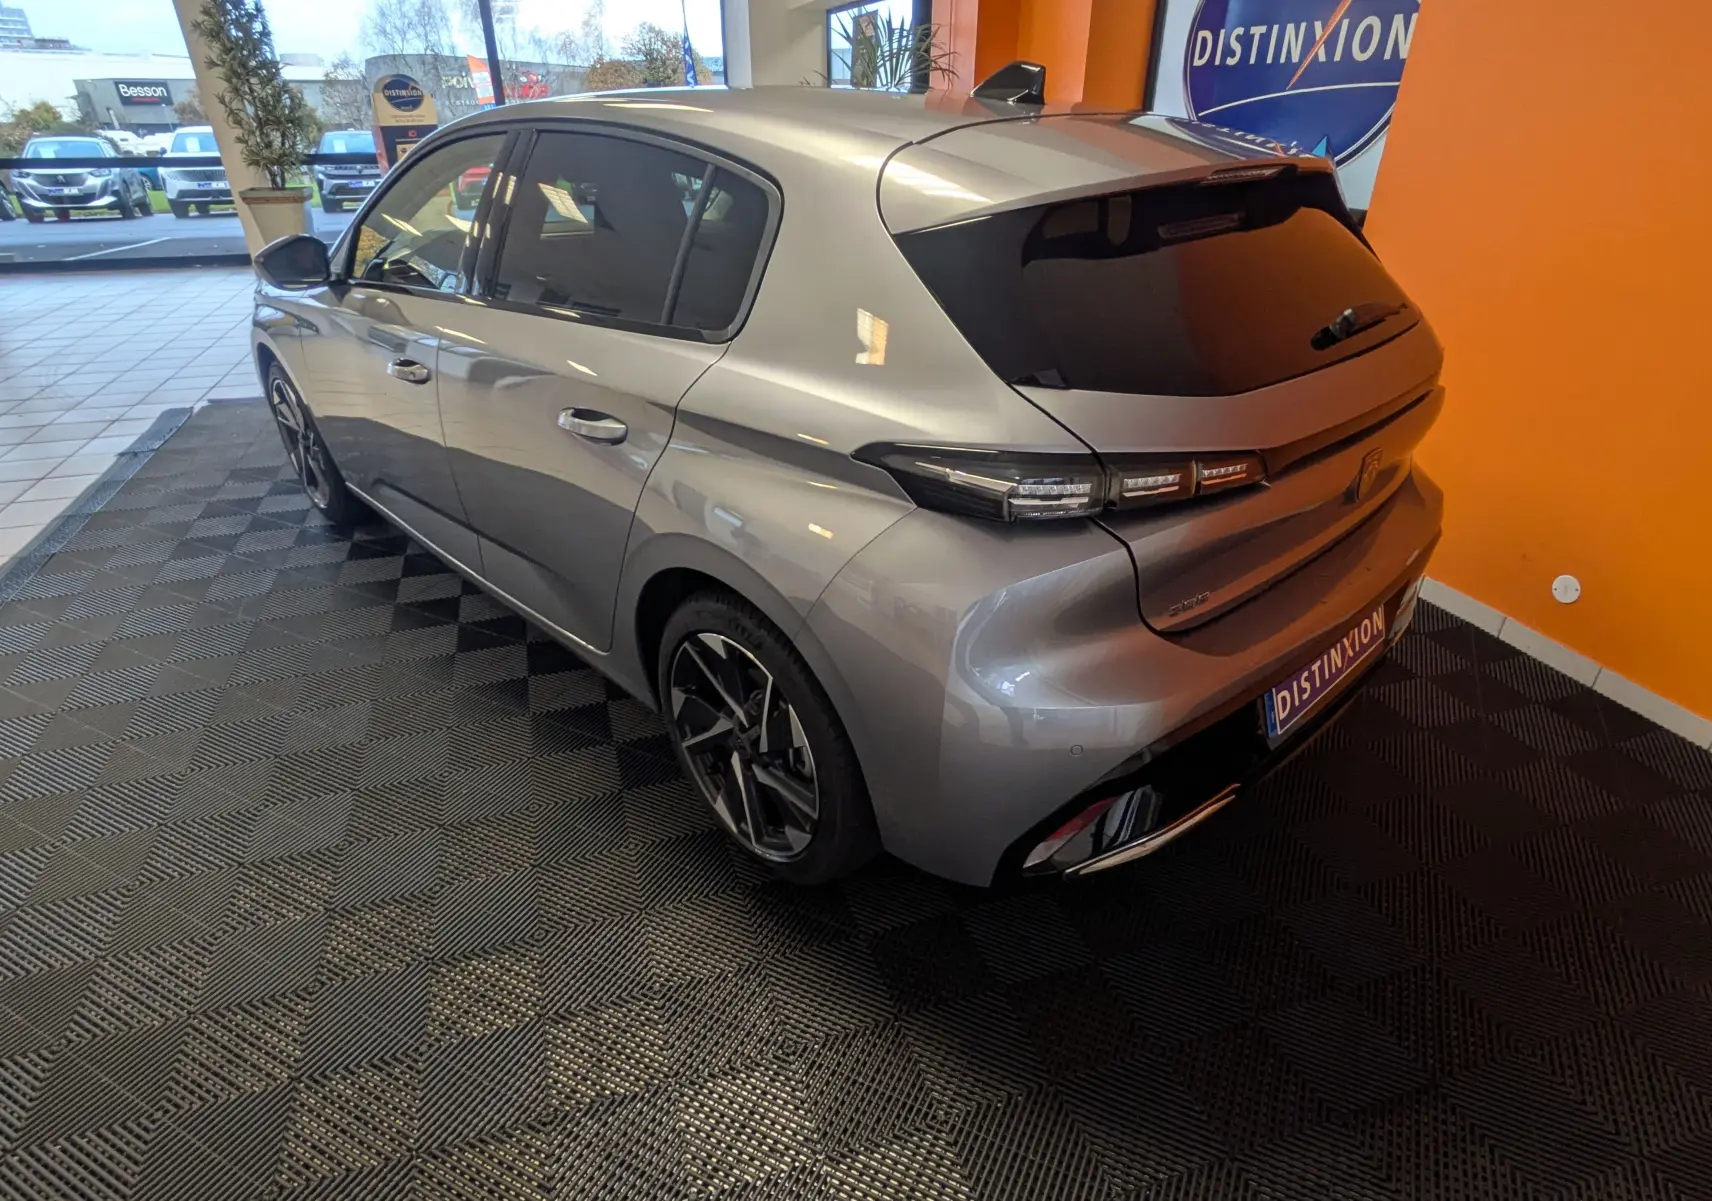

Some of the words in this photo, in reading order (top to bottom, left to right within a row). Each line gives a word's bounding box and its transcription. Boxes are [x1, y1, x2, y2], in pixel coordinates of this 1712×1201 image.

[1193, 12, 1419, 67] DISTINXION
[118, 83, 168, 97] Besson
[1276, 606, 1384, 721] DISTINXION
